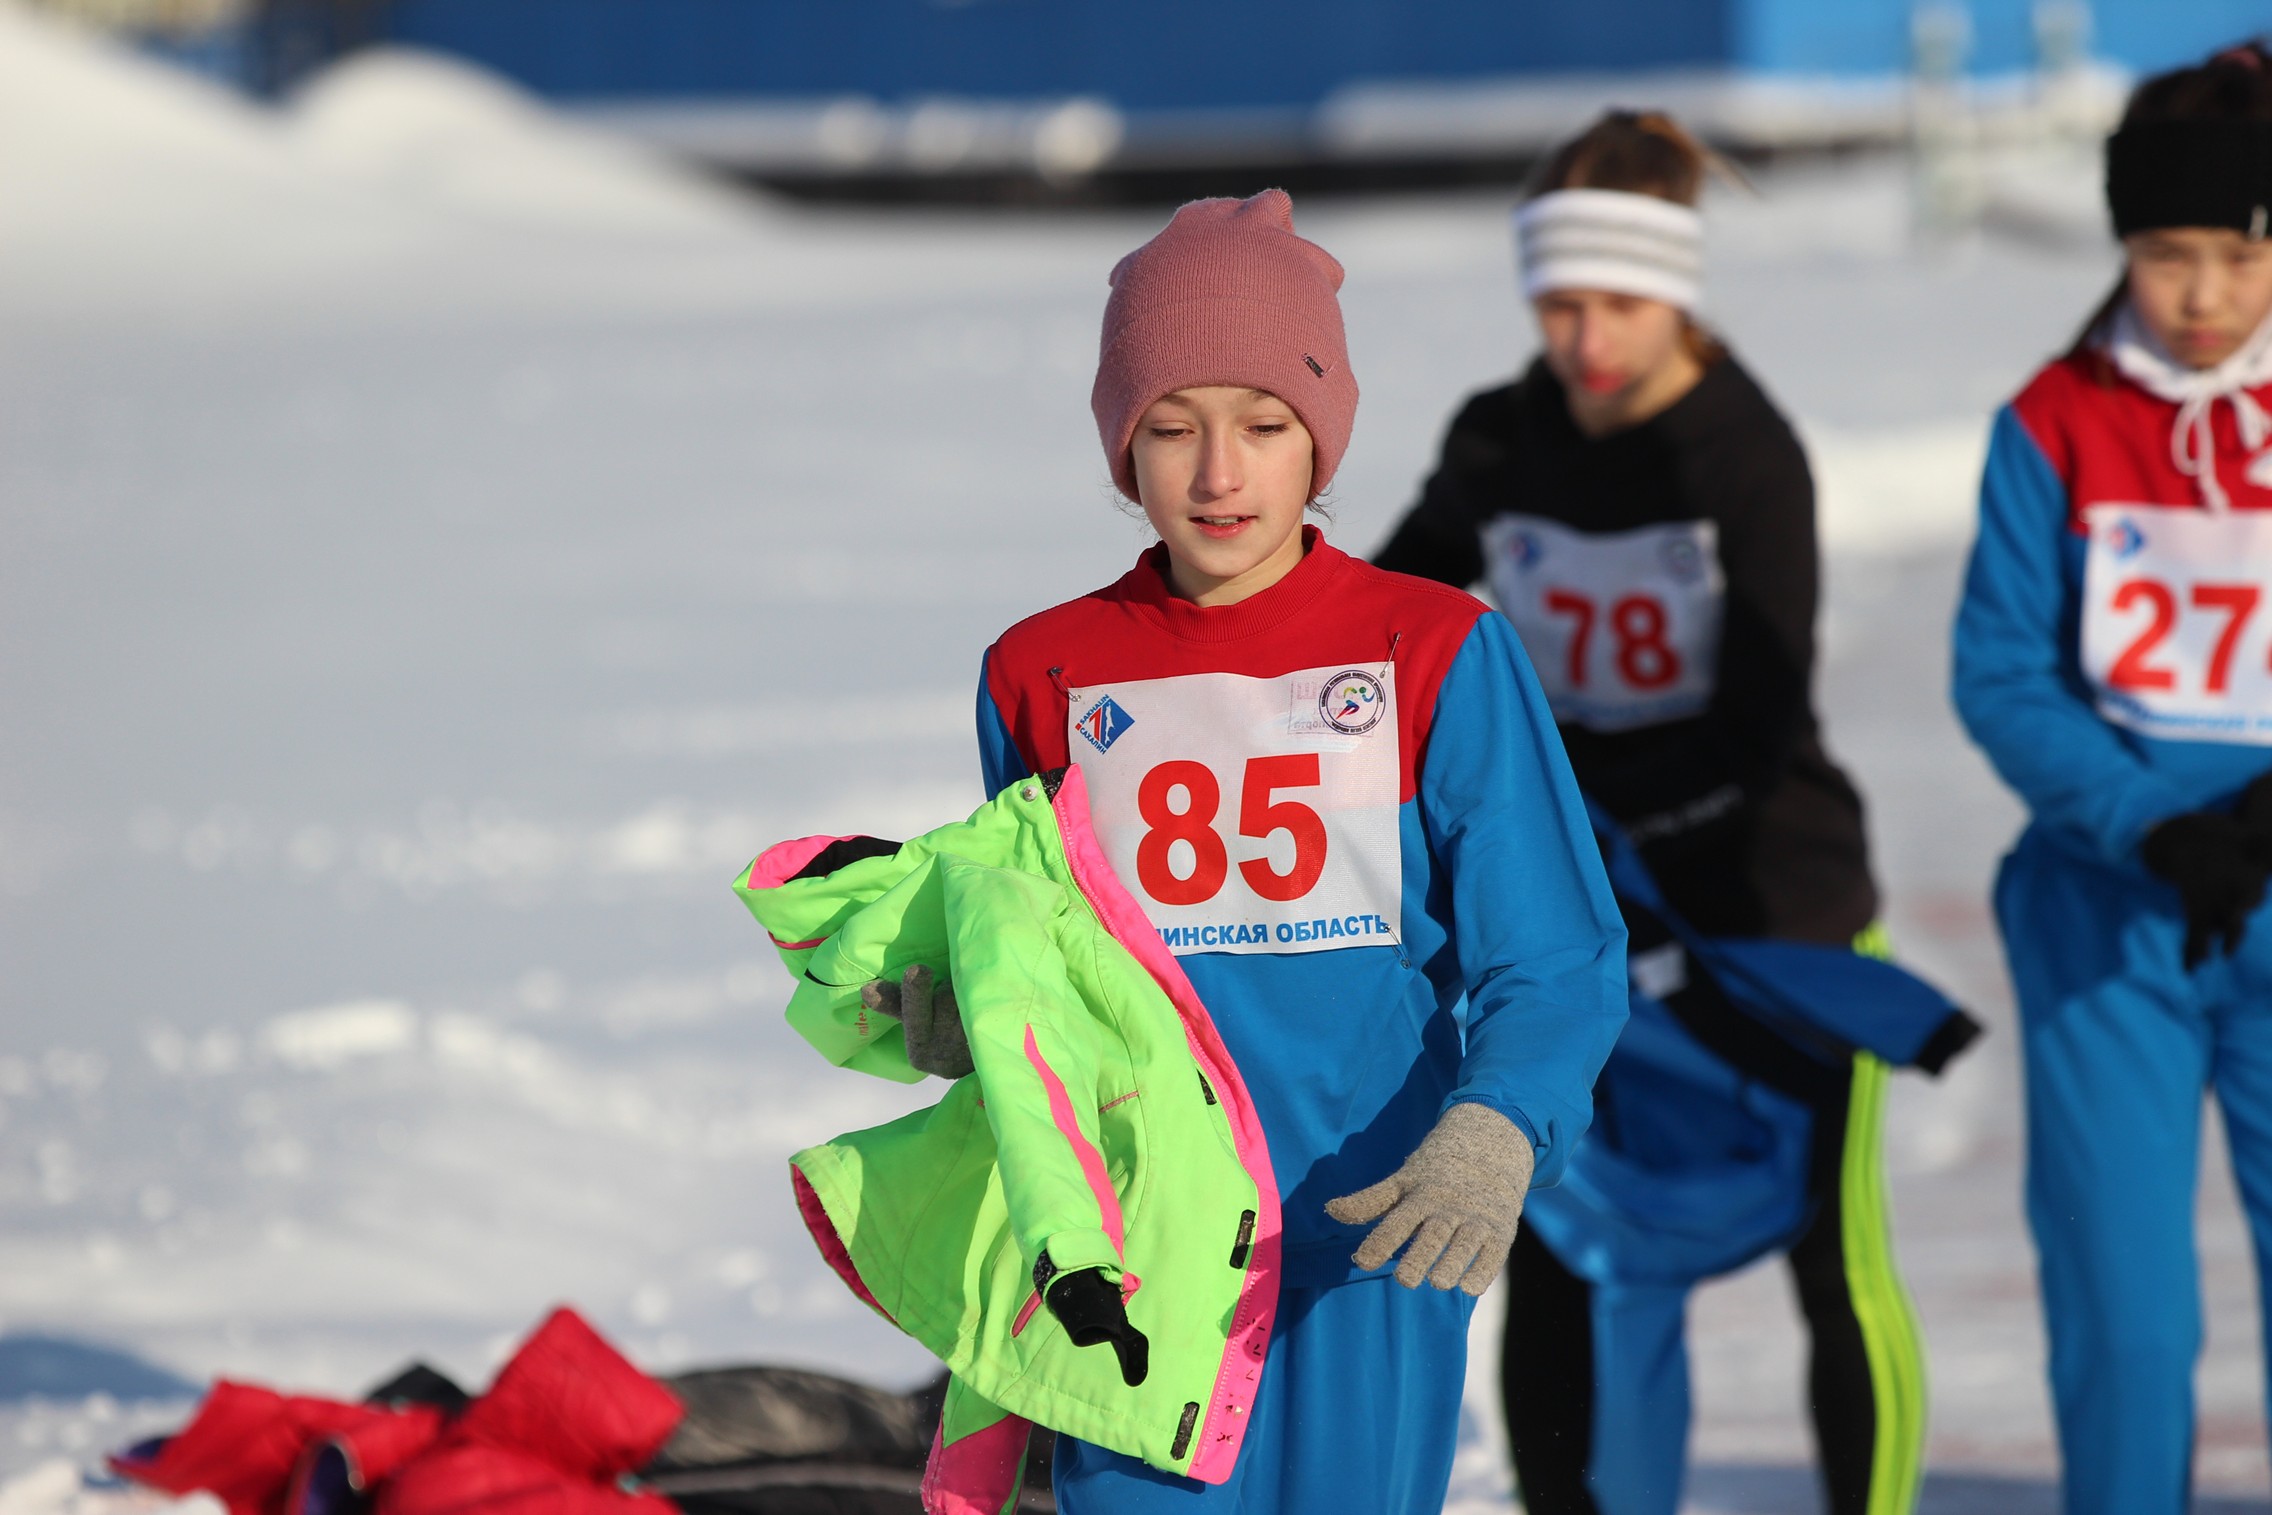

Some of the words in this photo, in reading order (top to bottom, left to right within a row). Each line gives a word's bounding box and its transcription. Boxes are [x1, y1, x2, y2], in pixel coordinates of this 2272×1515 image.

[1543, 589, 1683, 691] 78
[2108, 578, 2272, 695] 27
[1079, 694, 1109, 725] SAKHALIN
[1080, 727, 1107, 755] САХАЛИН
[1137, 752, 1327, 906] 85
[1155, 923, 1268, 948] ИНСКАЯ
[1275, 914, 1389, 942] ОБЛАСТЬ
